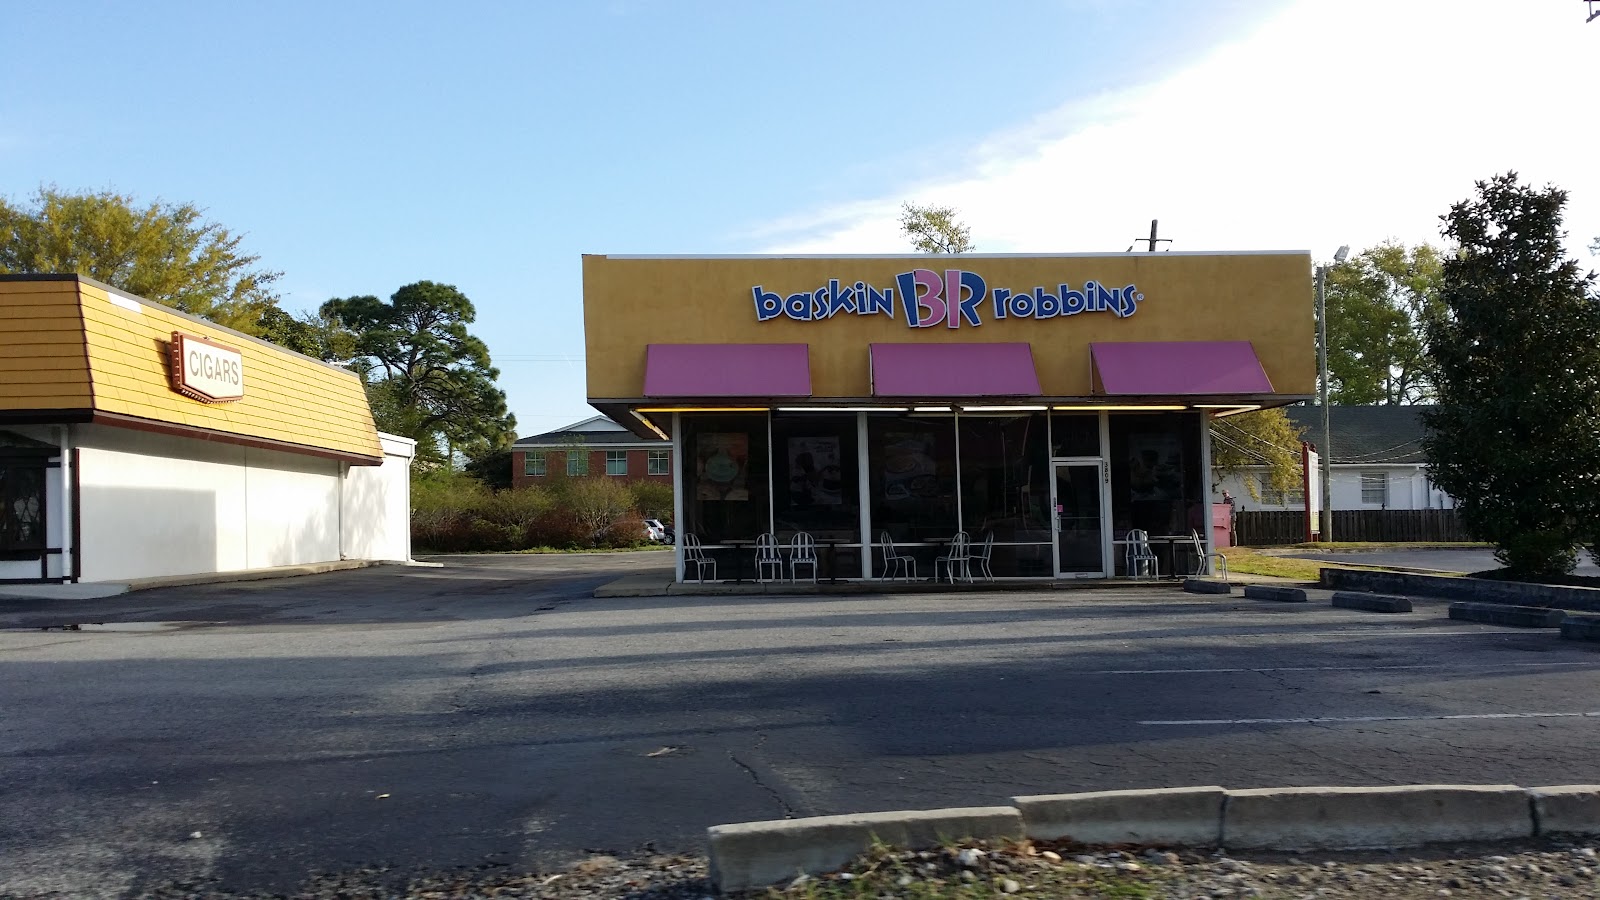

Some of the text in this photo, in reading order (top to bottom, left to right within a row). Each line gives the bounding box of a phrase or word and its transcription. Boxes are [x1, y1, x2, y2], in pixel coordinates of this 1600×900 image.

[752, 280, 894, 320] baskin
[895, 269, 986, 328] BR
[189, 351, 239, 385] CIGARS
